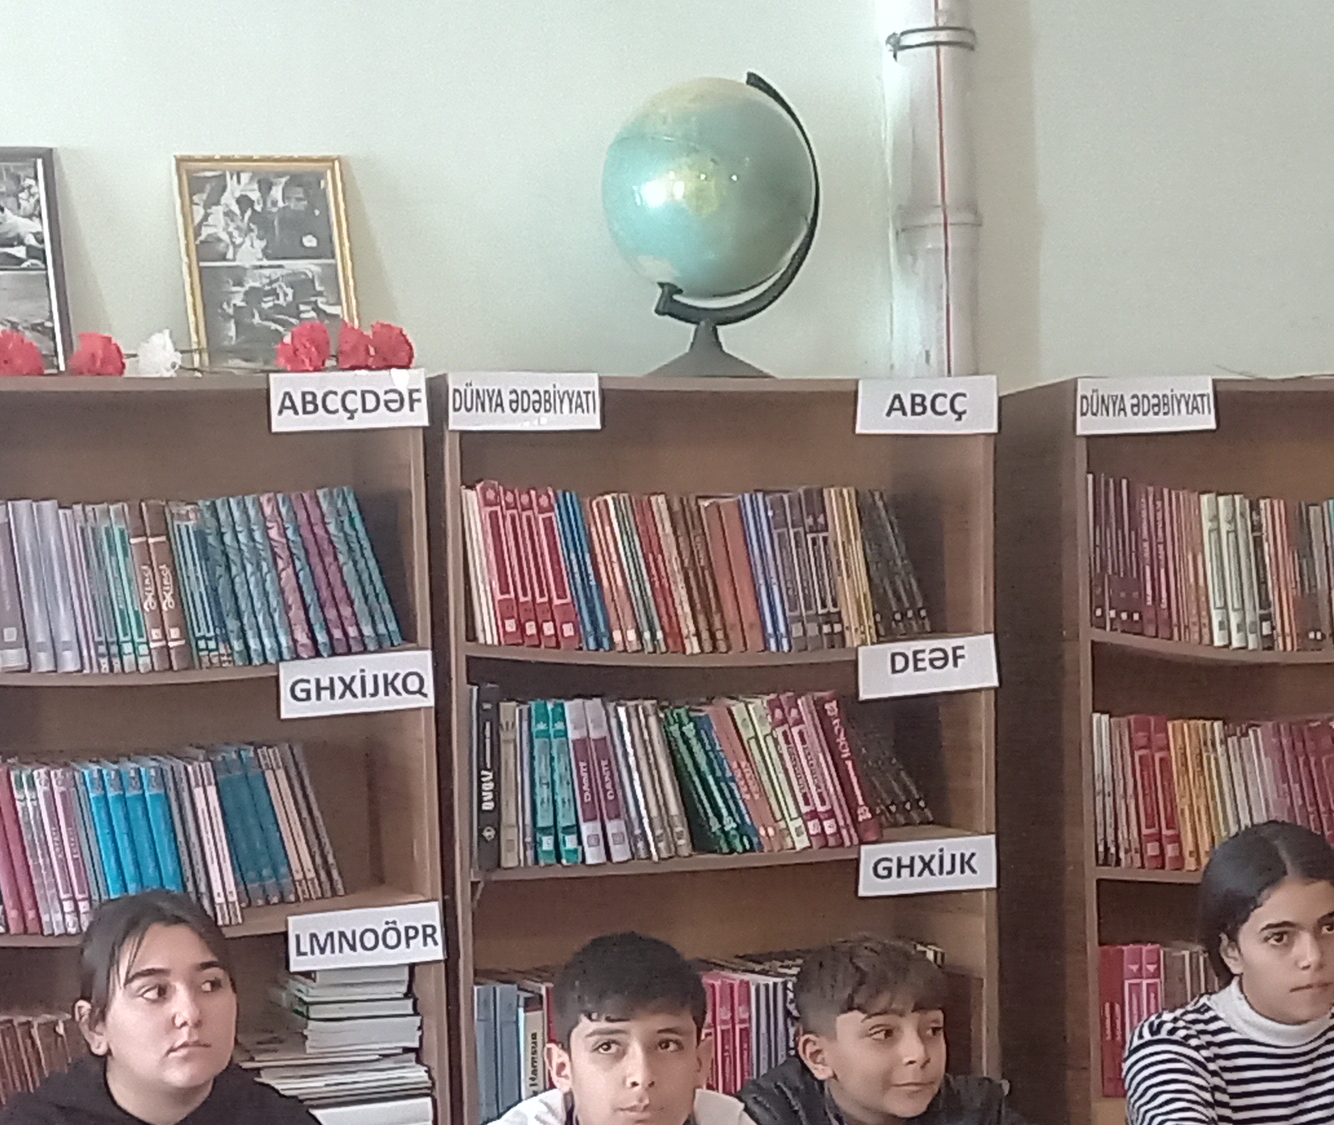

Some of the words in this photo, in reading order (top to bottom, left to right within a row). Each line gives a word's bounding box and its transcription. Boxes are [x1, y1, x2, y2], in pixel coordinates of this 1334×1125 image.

[277, 388, 422, 420] ABCÇDƏF
[452, 382, 505, 414] DÜNYA
[508, 384, 597, 415] ƏDƏBİYYATI
[885, 392, 969, 422] ABCÇ
[1079, 388, 1128, 417] DÜNYA
[1130, 388, 1212, 417] ƏDƏBİYYATI
[889, 646, 968, 675] DEƏF
[289, 668, 429, 703] GHXİJKQ
[871, 847, 978, 880] GHXİJK
[294, 919, 439, 958] LMNOÖPR
